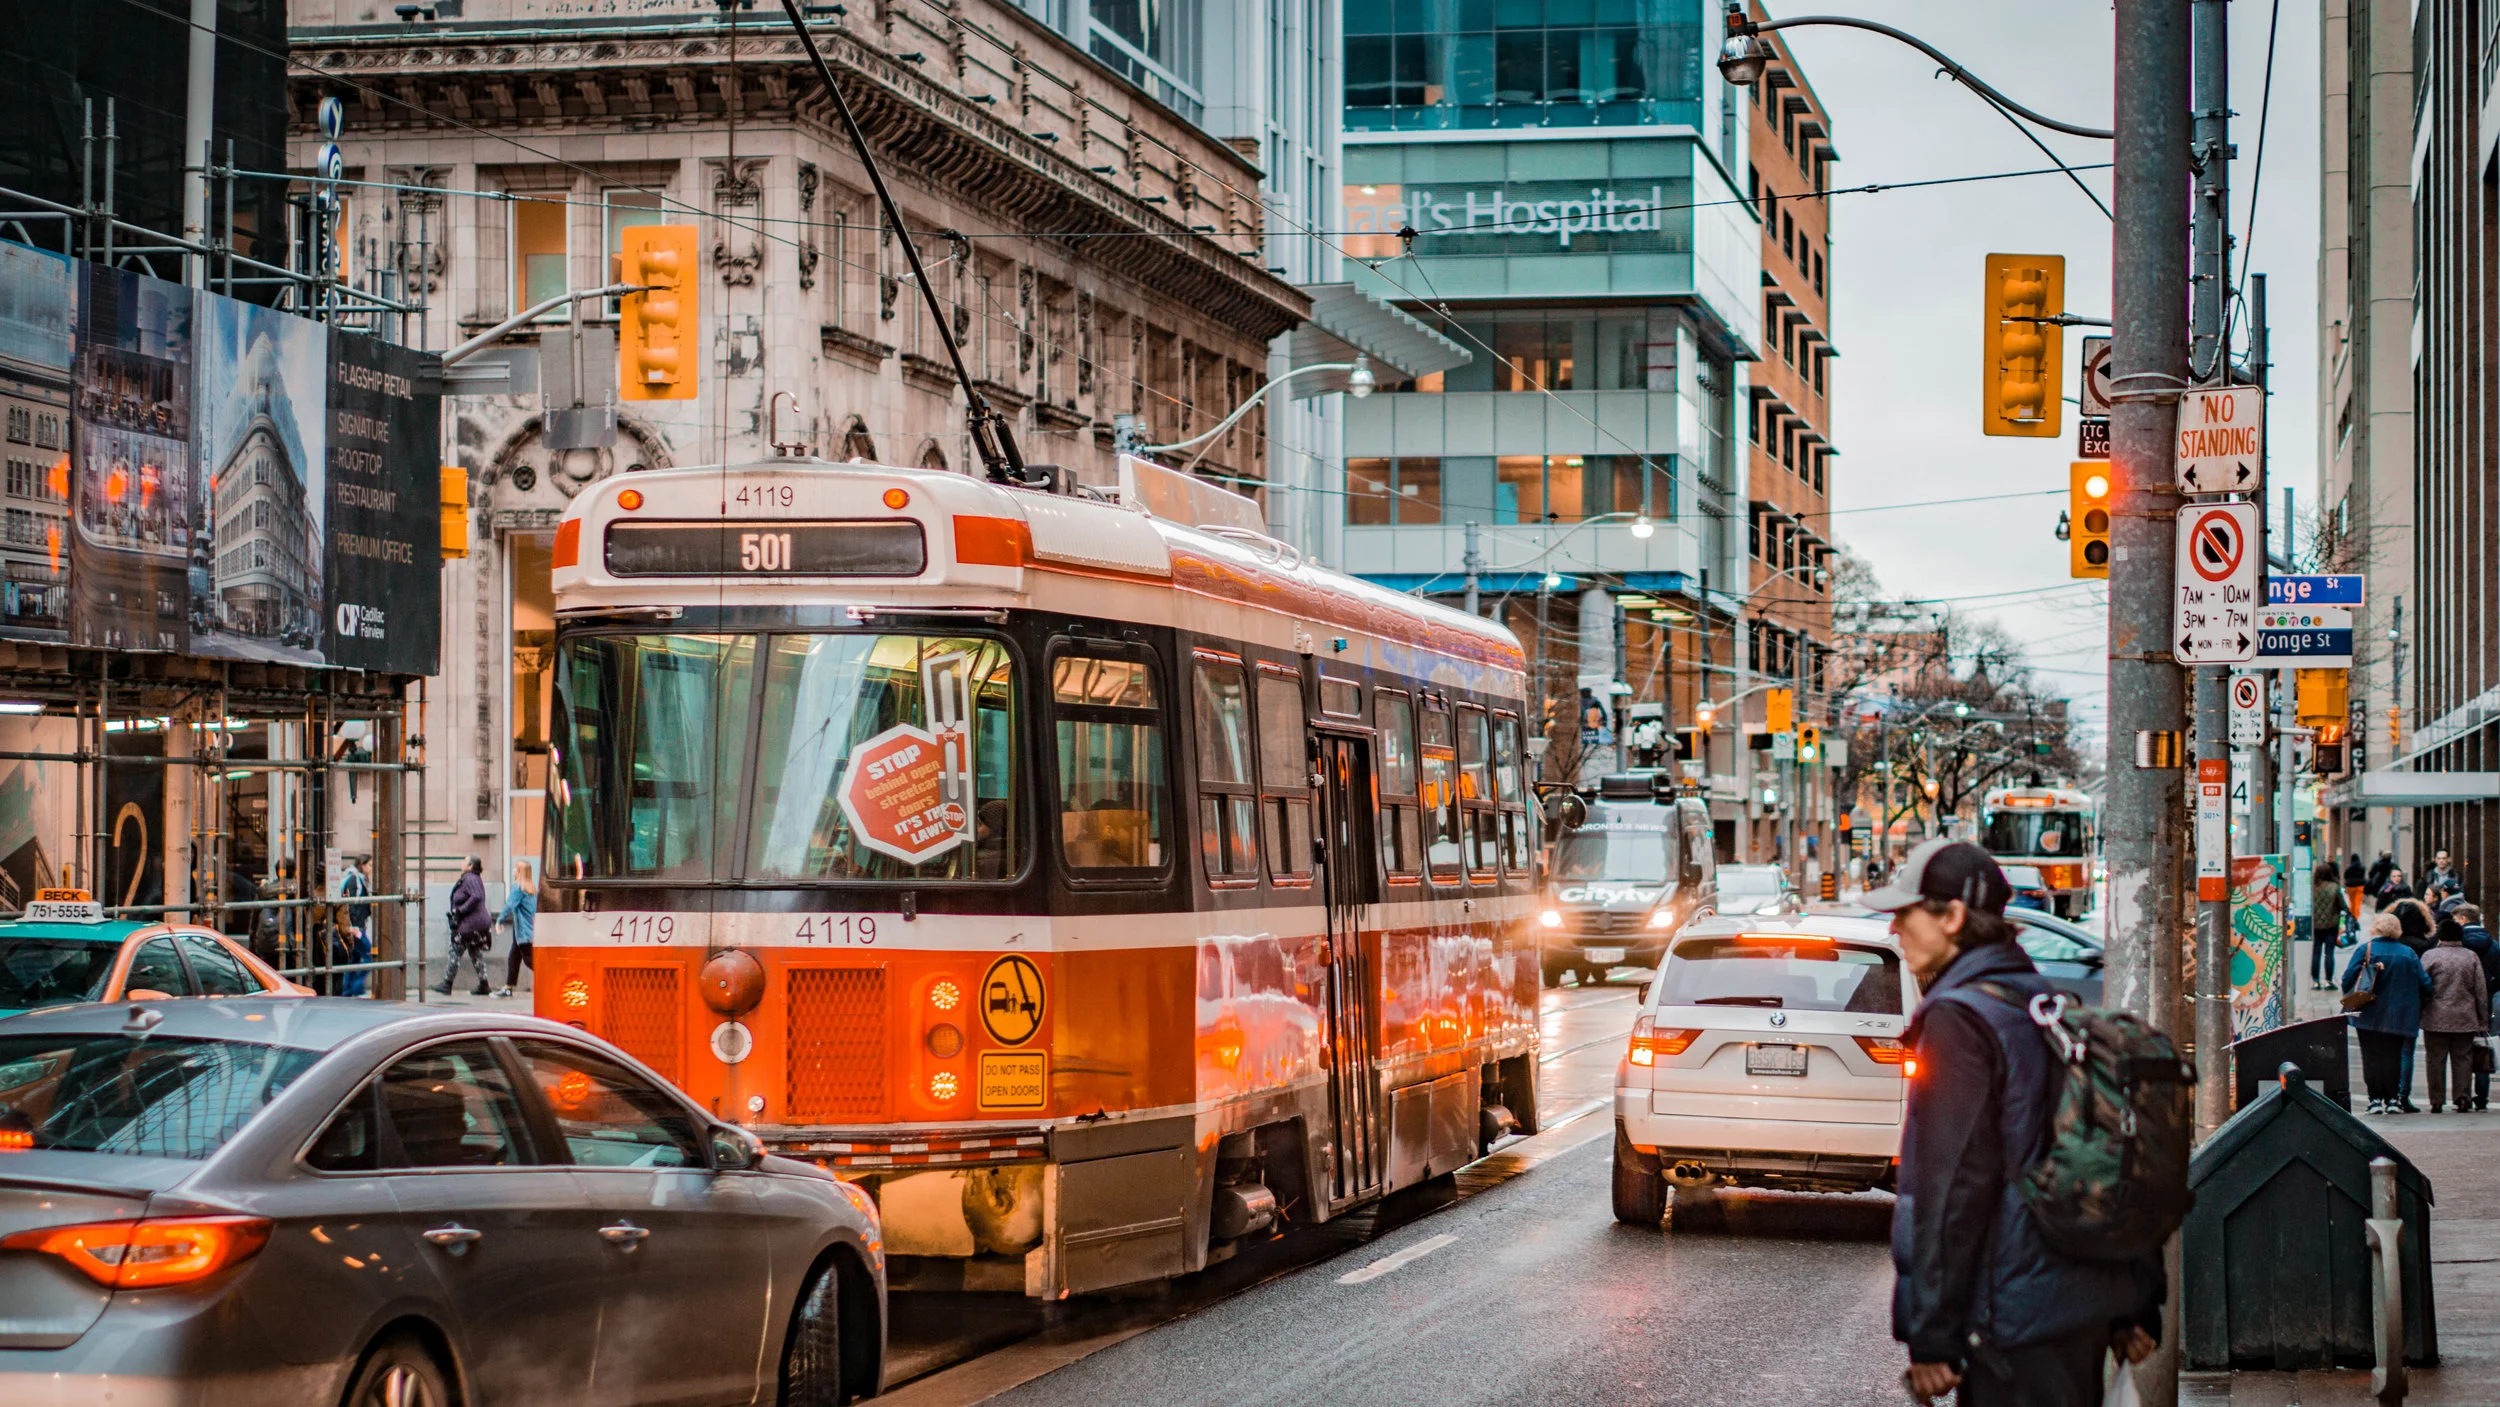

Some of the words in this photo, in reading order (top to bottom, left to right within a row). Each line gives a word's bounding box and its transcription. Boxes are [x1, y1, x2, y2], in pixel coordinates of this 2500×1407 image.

[1343, 190, 1453, 236] ael's
[1466, 186, 1661, 246] Hospital
[338, 361, 382, 392] FLAGSHIP
[384, 373, 413, 401] RETAIL
[2205, 394, 2234, 424] NO
[338, 411, 389, 444] SIGNATURE
[2082, 424, 2104, 438] TTC
[2180, 426, 2256, 459] STANDING
[338, 446, 382, 475] ROOFTOP
[338, 482, 397, 513] RESTAURANT
[736, 485, 794, 507] 4119
[337, 532, 380, 559] PREMIUM
[381, 539, 413, 565] OFFICE
[741, 533, 792, 571] 501
[2326, 577, 2339, 589] St
[2182, 586, 2203, 605] 7AM
[2223, 584, 2251, 604] 10AM
[337, 602, 360, 637] CF
[361, 605, 385, 624] Cadillac
[2183, 610, 2206, 629] 3PM
[2225, 608, 2248, 628] 7PM
[361, 622, 385, 639] Fairview
[2197, 639, 2212, 650] MON
[2221, 638, 2233, 649] FRI
[2257, 632, 2312, 653] Yonge
[2316, 632, 2331, 647] St
[866, 744, 921, 780] STOP
[864, 772, 909, 800] behind
[910, 760, 941, 780] open
[2205, 787, 2218, 795] 501
[880, 777, 938, 810] streetcar
[897, 795, 935, 818] doors
[944, 811, 964, 822] STOP
[894, 815, 923, 836] IT'S
[923, 803, 946, 822] THE
[1571, 823, 1632, 832] ORONTO'S
[1635, 823, 1668, 832] NEWS
[910, 821, 946, 845] LAW!
[44, 890, 81, 901] BECK
[1560, 886, 1658, 908] Citytv
[32, 904, 89, 918] 751-5555
[610, 915, 675, 944] 4119
[795, 915, 877, 945] 4119
[985, 1064, 998, 1076] DO
[1000, 1064, 1017, 1076] NOT
[1019, 1064, 1040, 1075] PASS
[985, 1085, 1008, 1097] OPEN
[1010, 1085, 1040, 1096] DOORS
